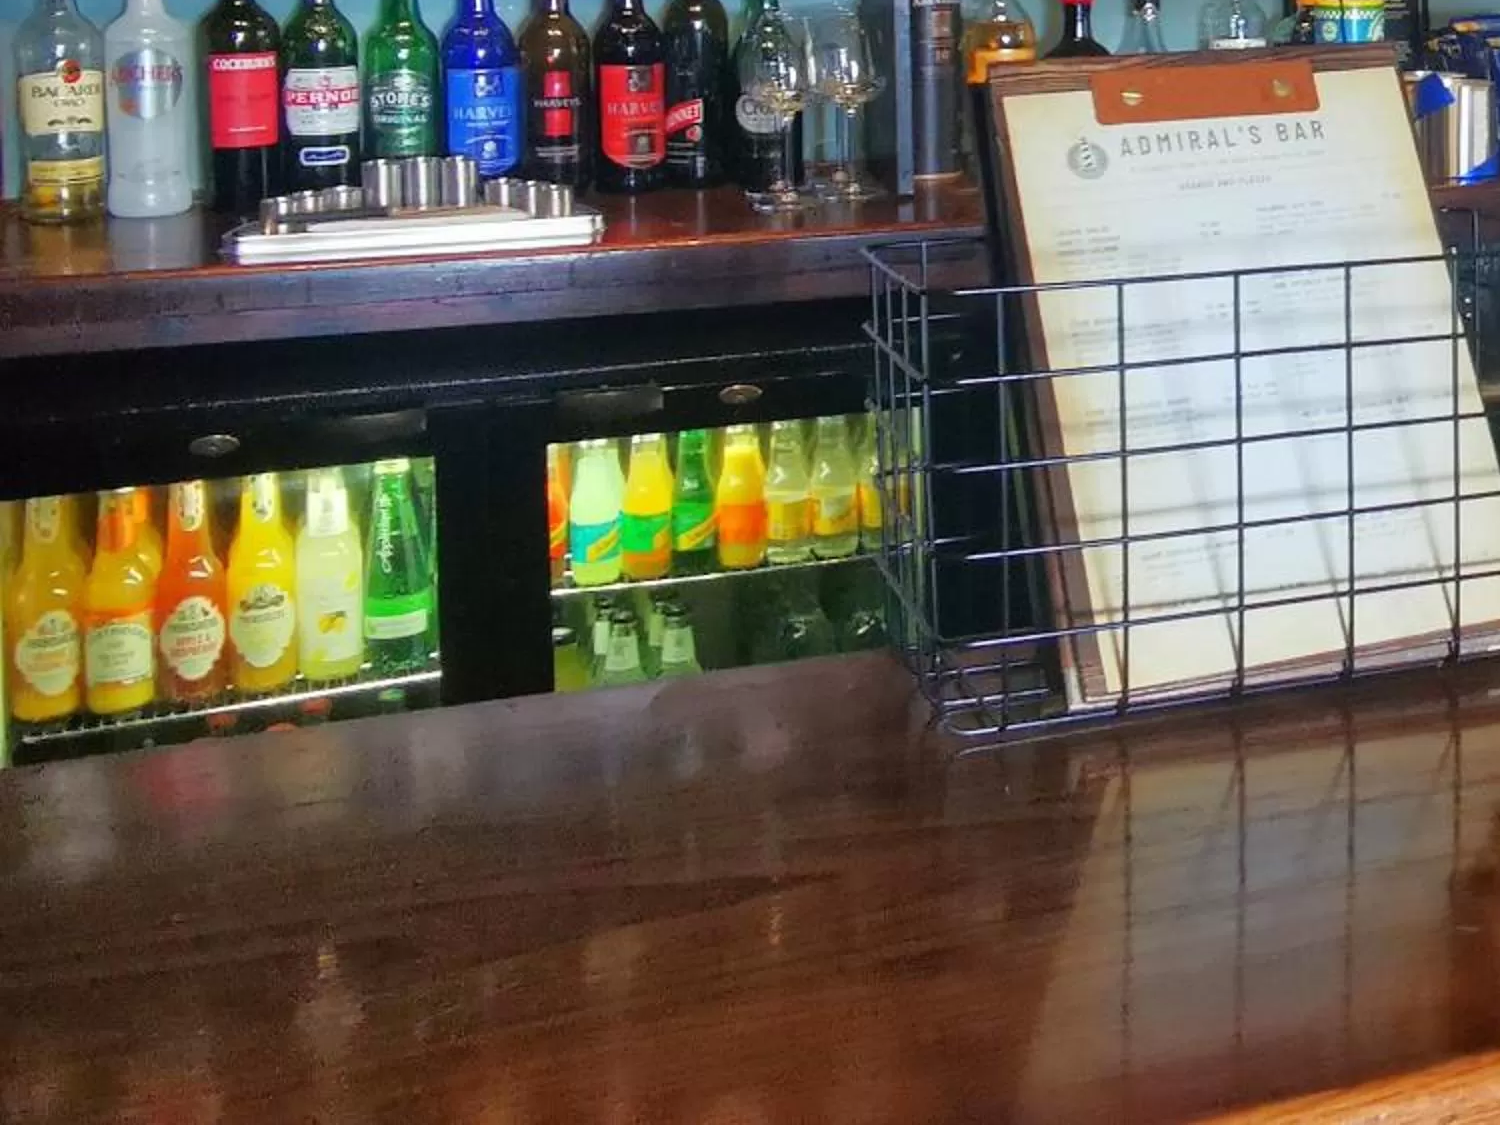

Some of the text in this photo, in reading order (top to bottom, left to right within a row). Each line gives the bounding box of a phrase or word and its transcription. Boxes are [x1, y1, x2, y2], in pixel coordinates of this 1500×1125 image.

[370, 92, 432, 109] STONE'S
[1120, 120, 1326, 158] ADMIRAL'S BAR
